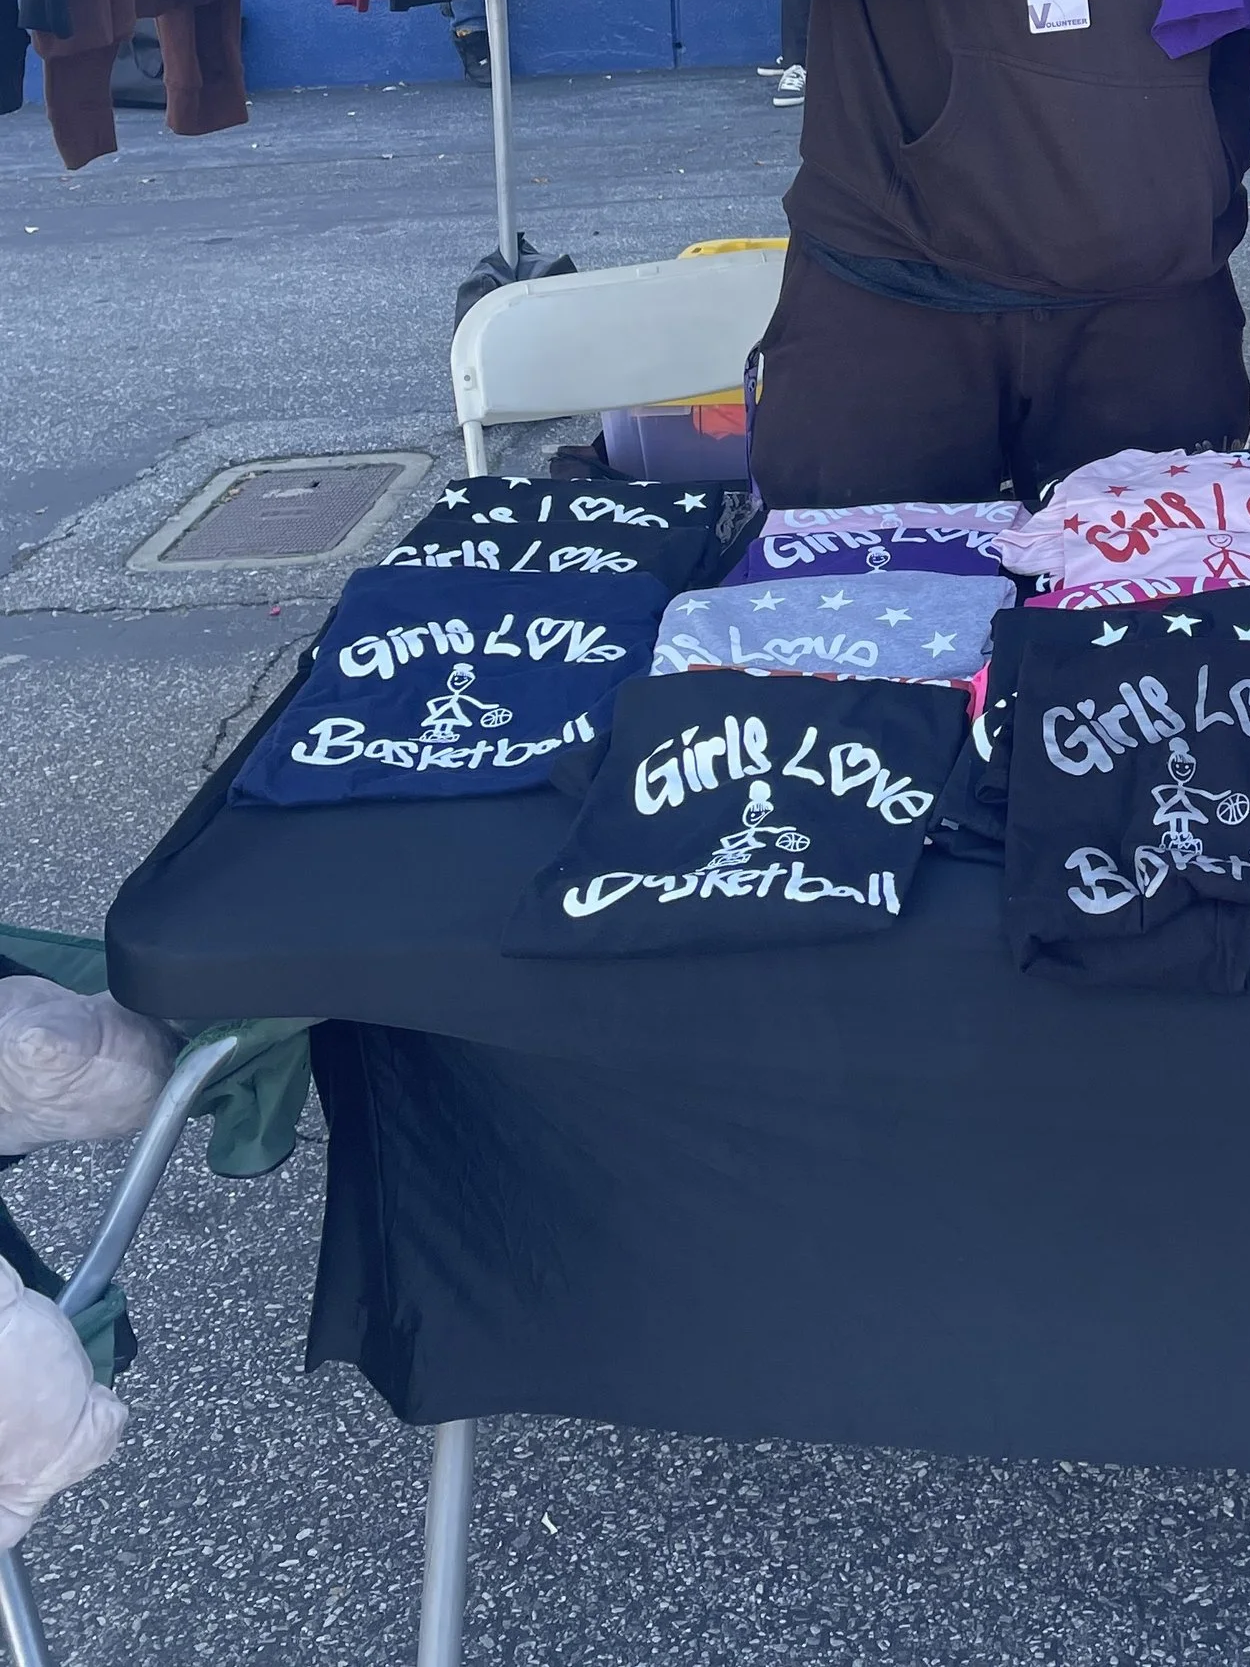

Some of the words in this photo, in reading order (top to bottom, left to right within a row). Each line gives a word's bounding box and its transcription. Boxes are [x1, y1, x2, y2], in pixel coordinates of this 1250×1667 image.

[1029, 3, 1088, 30] VOLUNTEER
[763, 530, 882, 569] Girls
[1086, 492, 1205, 563] Girls
[339, 619, 475, 680] Girls
[483, 613, 627, 663] Love
[729, 626, 878, 667] Love
[291, 712, 595, 771] Basketball
[1042, 676, 1185, 776] Girls
[634, 716, 773, 816] Girls
[782, 726, 934, 826] Love
